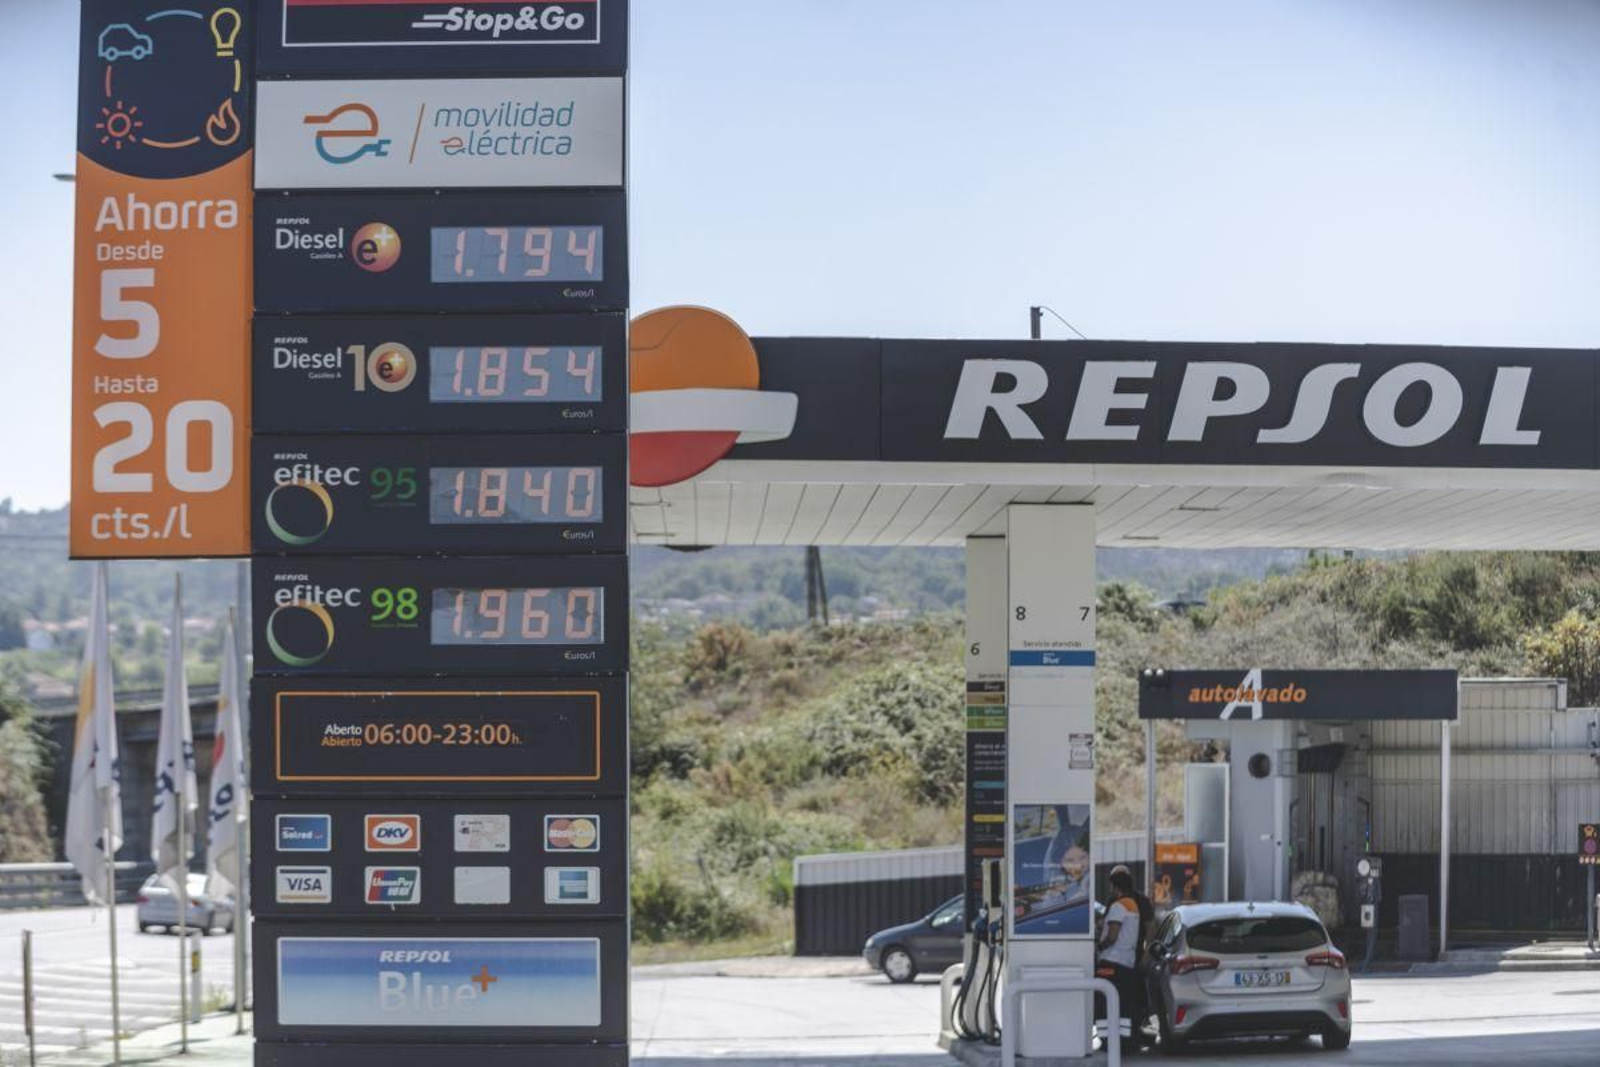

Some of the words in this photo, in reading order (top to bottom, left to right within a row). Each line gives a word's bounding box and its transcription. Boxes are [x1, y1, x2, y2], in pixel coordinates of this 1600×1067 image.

[445, 6, 585, 37] Stop&Go
[434, 101, 574, 127] movilidad
[440, 129, 572, 155] eléctrica
[94, 193, 239, 232] Ahorra
[96, 240, 164, 261] Desde
[275, 228, 344, 249] Diesel
[454, 227, 597, 276] 1.794
[94, 267, 160, 359] 5
[273, 347, 342, 369] Diesel
[94, 375, 159, 394] Hasta
[453, 347, 595, 396] 1.854
[944, 359, 1541, 447] REPSOL
[93, 400, 234, 492] 20
[274, 464, 361, 486] efitec
[370, 468, 417, 500] 95
[454, 468, 595, 517] 1.840
[91, 503, 192, 539] cts./l
[274, 585, 361, 607] efitec
[371, 588, 418, 620] 98
[453, 589, 596, 639] 1.960
[1016, 606, 1026, 621] 8
[1080, 606, 1090, 621] 7
[970, 643, 980, 656] 6
[1188, 683, 1307, 703] autolavado
[321, 736, 362, 747] Abierto
[324, 724, 362, 736] Aberto
[376, 827, 409, 839] DKV
[287, 877, 323, 891] VISA
[380, 950, 452, 962] REPSOL
